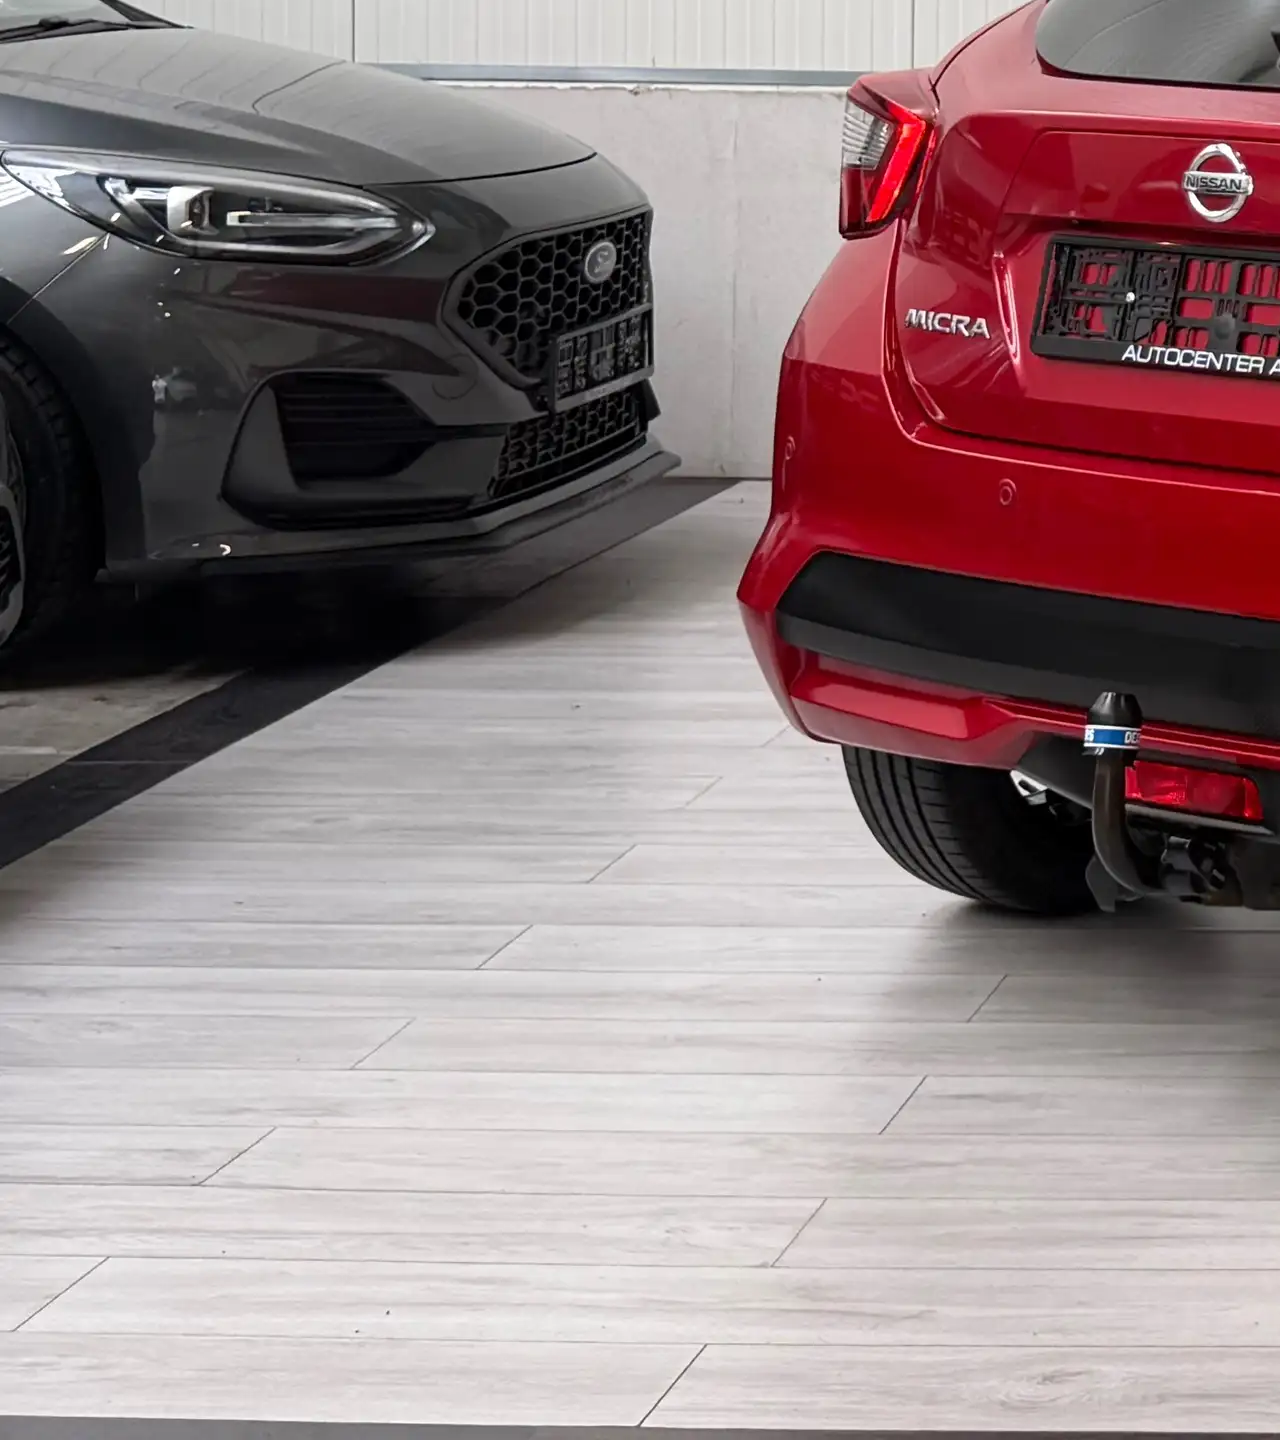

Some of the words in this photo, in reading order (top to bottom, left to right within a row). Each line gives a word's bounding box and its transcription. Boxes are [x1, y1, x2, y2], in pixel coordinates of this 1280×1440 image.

[1186, 174, 1242, 191] NISSAN
[904, 308, 991, 340] MICRA
[1121, 344, 1265, 375] AUTOCENTER
